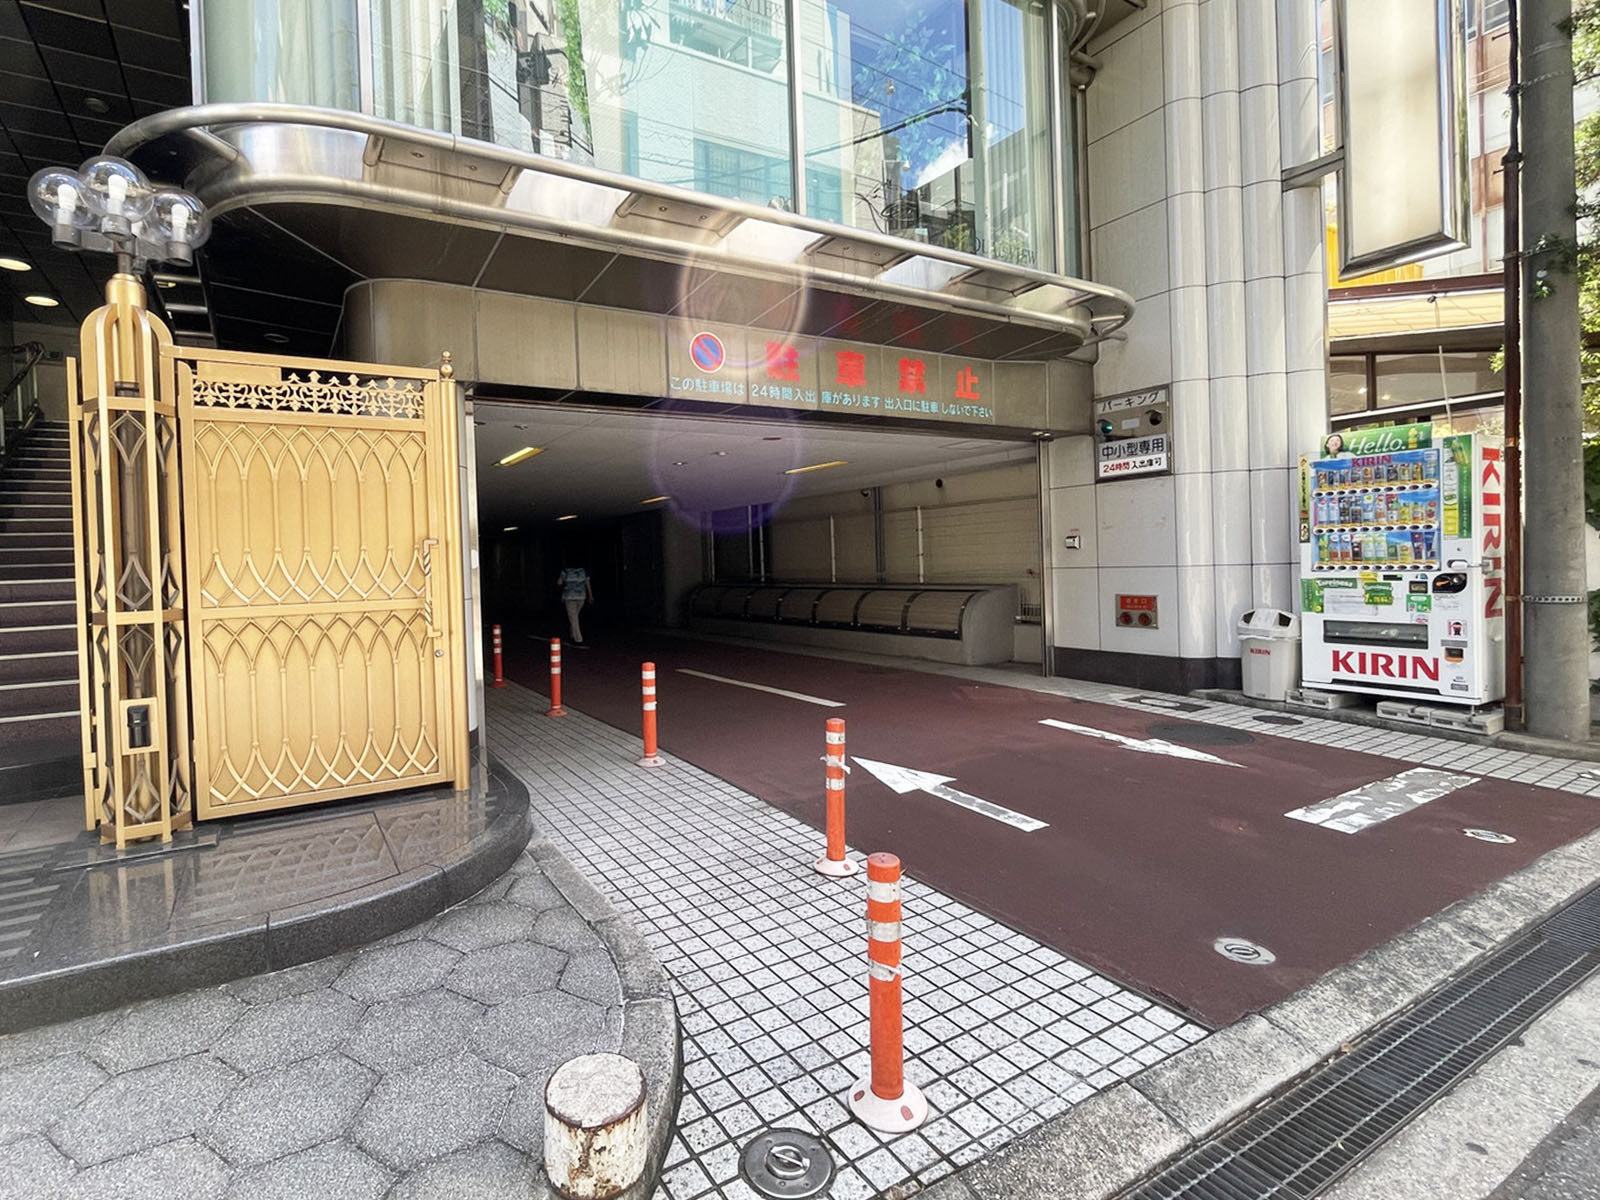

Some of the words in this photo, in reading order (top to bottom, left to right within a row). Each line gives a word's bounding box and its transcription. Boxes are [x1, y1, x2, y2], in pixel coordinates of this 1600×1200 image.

[1102, 391, 1159, 412] パーキング
[1102, 437, 1164, 460] 中小型専用
[1348, 432, 1406, 455] Hello.
[1351, 454, 1392, 467] KIRIN
[1249, 647, 1271, 656] KIRIN
[1331, 649, 1440, 682] KIRIN
